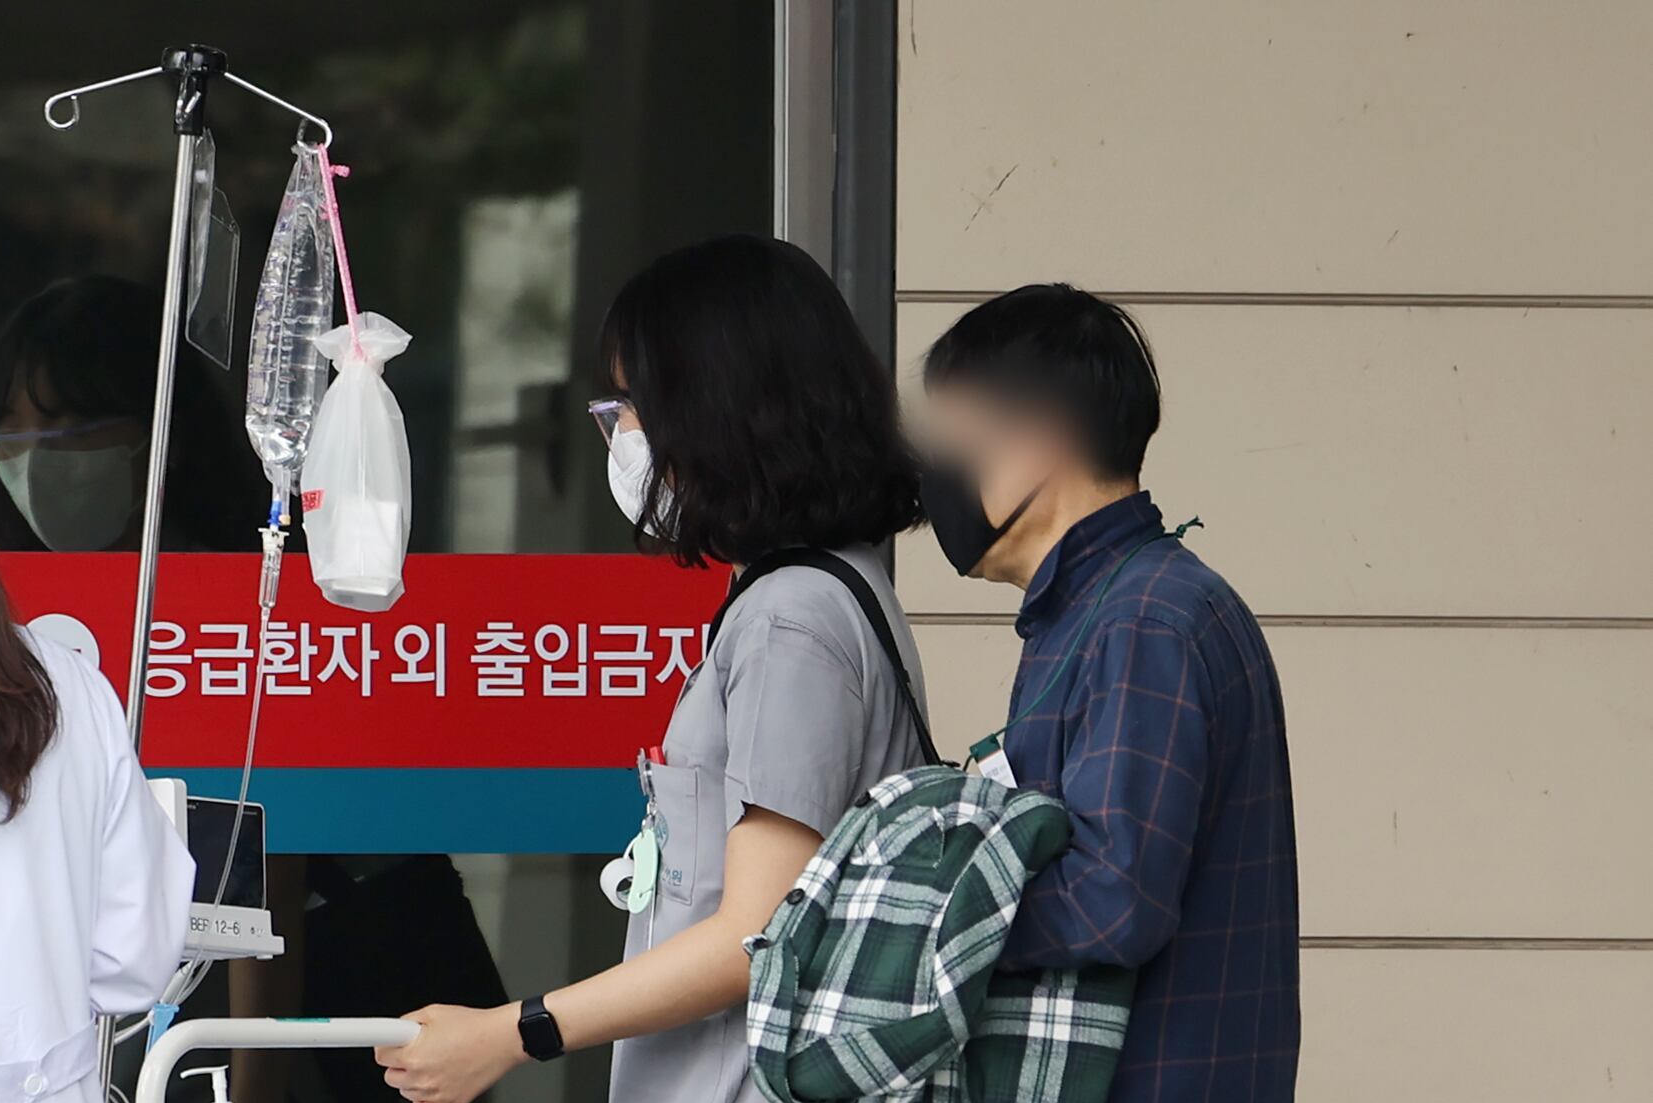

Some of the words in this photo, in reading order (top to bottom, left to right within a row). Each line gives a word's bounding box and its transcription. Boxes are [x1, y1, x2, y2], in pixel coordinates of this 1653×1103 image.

[145, 621, 380, 697] 응급환자
[391, 623, 446, 697] 외
[215, 920, 240, 935] 12-6
